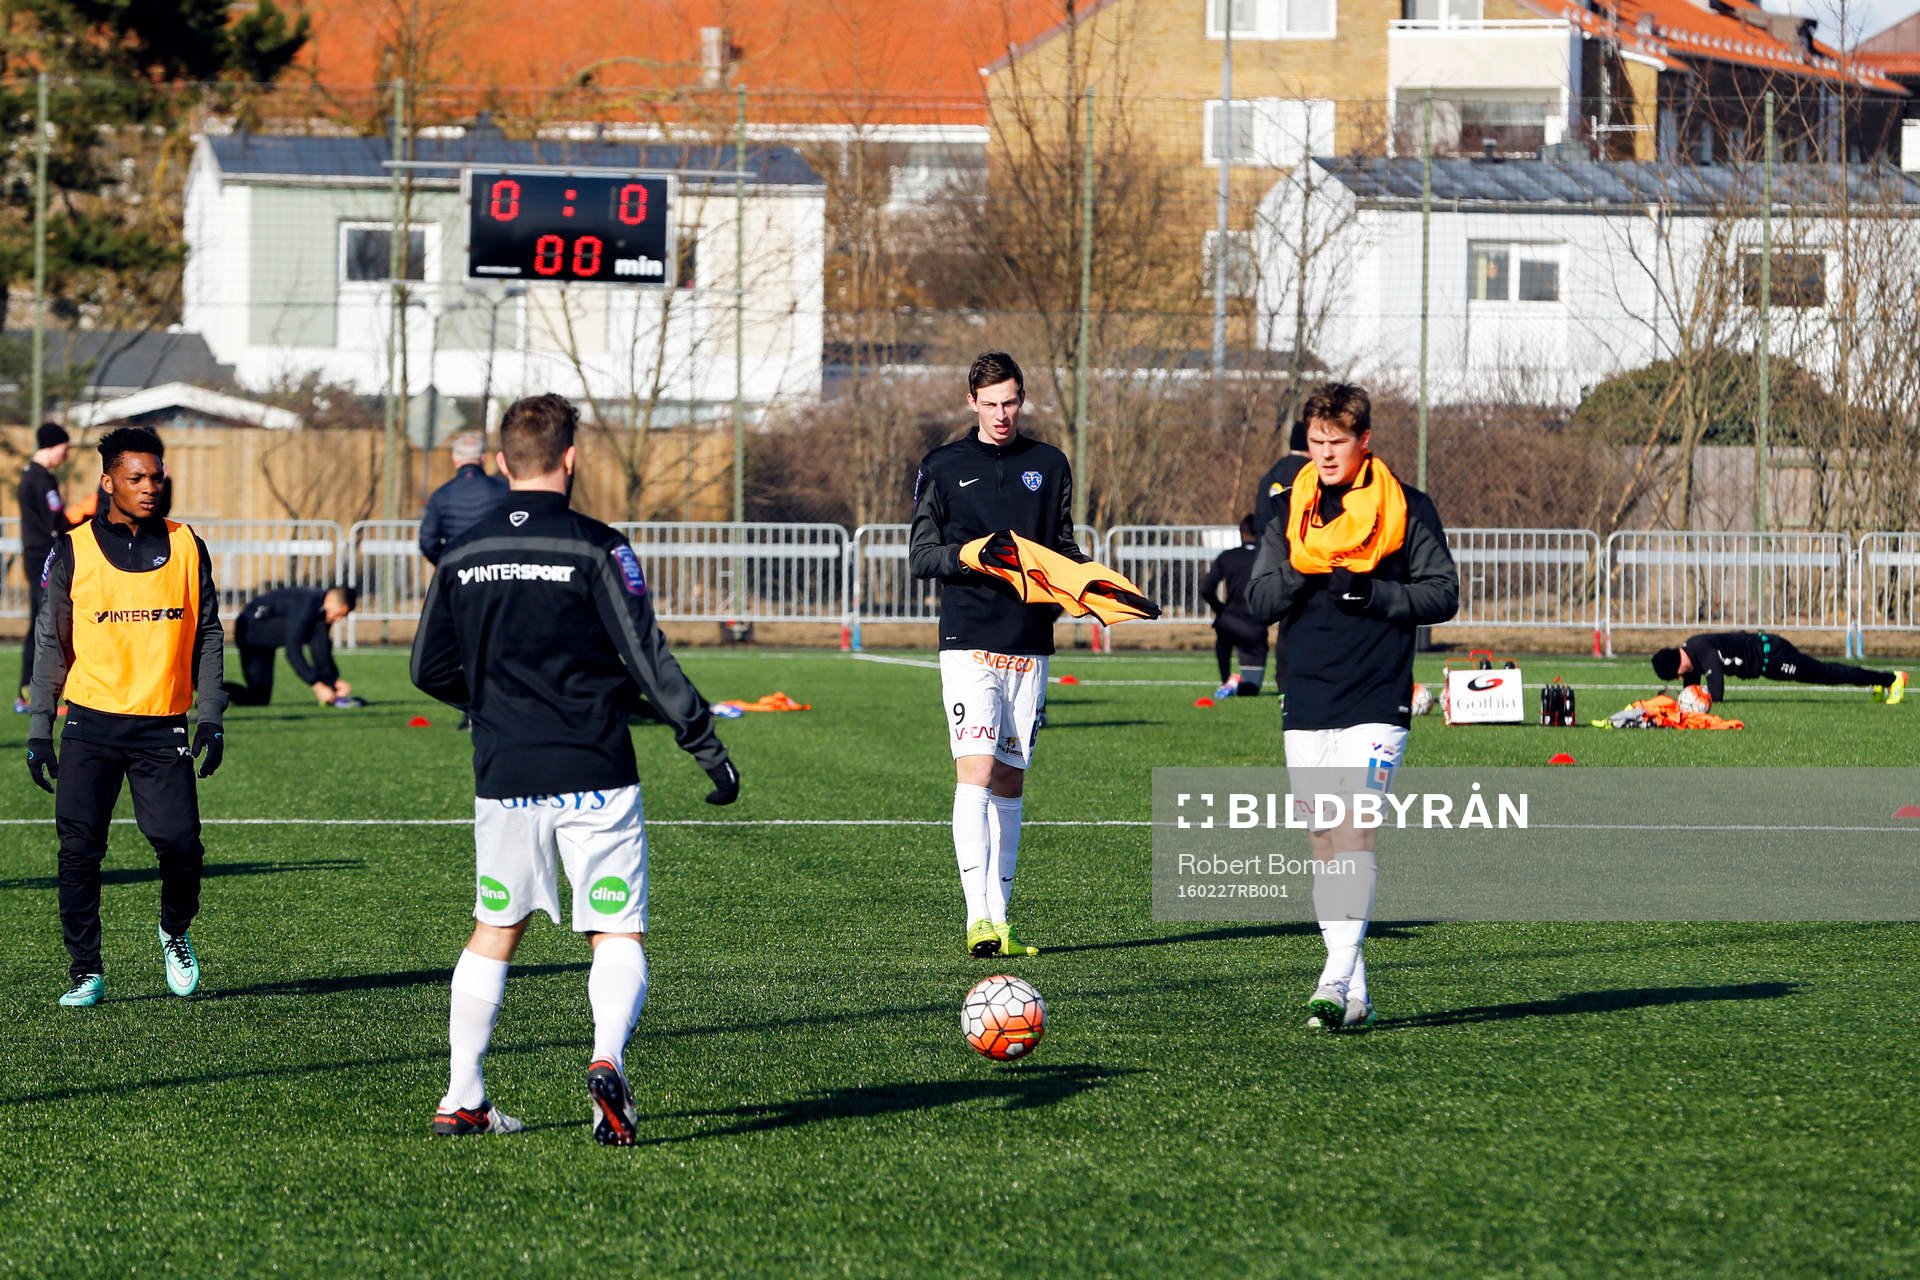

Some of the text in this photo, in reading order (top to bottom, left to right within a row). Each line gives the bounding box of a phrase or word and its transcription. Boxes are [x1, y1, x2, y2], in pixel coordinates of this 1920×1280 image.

[490, 180, 521, 221] 0
[618, 184, 648, 225] 0
[534, 235, 663, 277] 00 min
[474, 563, 575, 583] INTERSPORT
[953, 702, 966, 726] 9
[592, 886, 627, 902] dina
